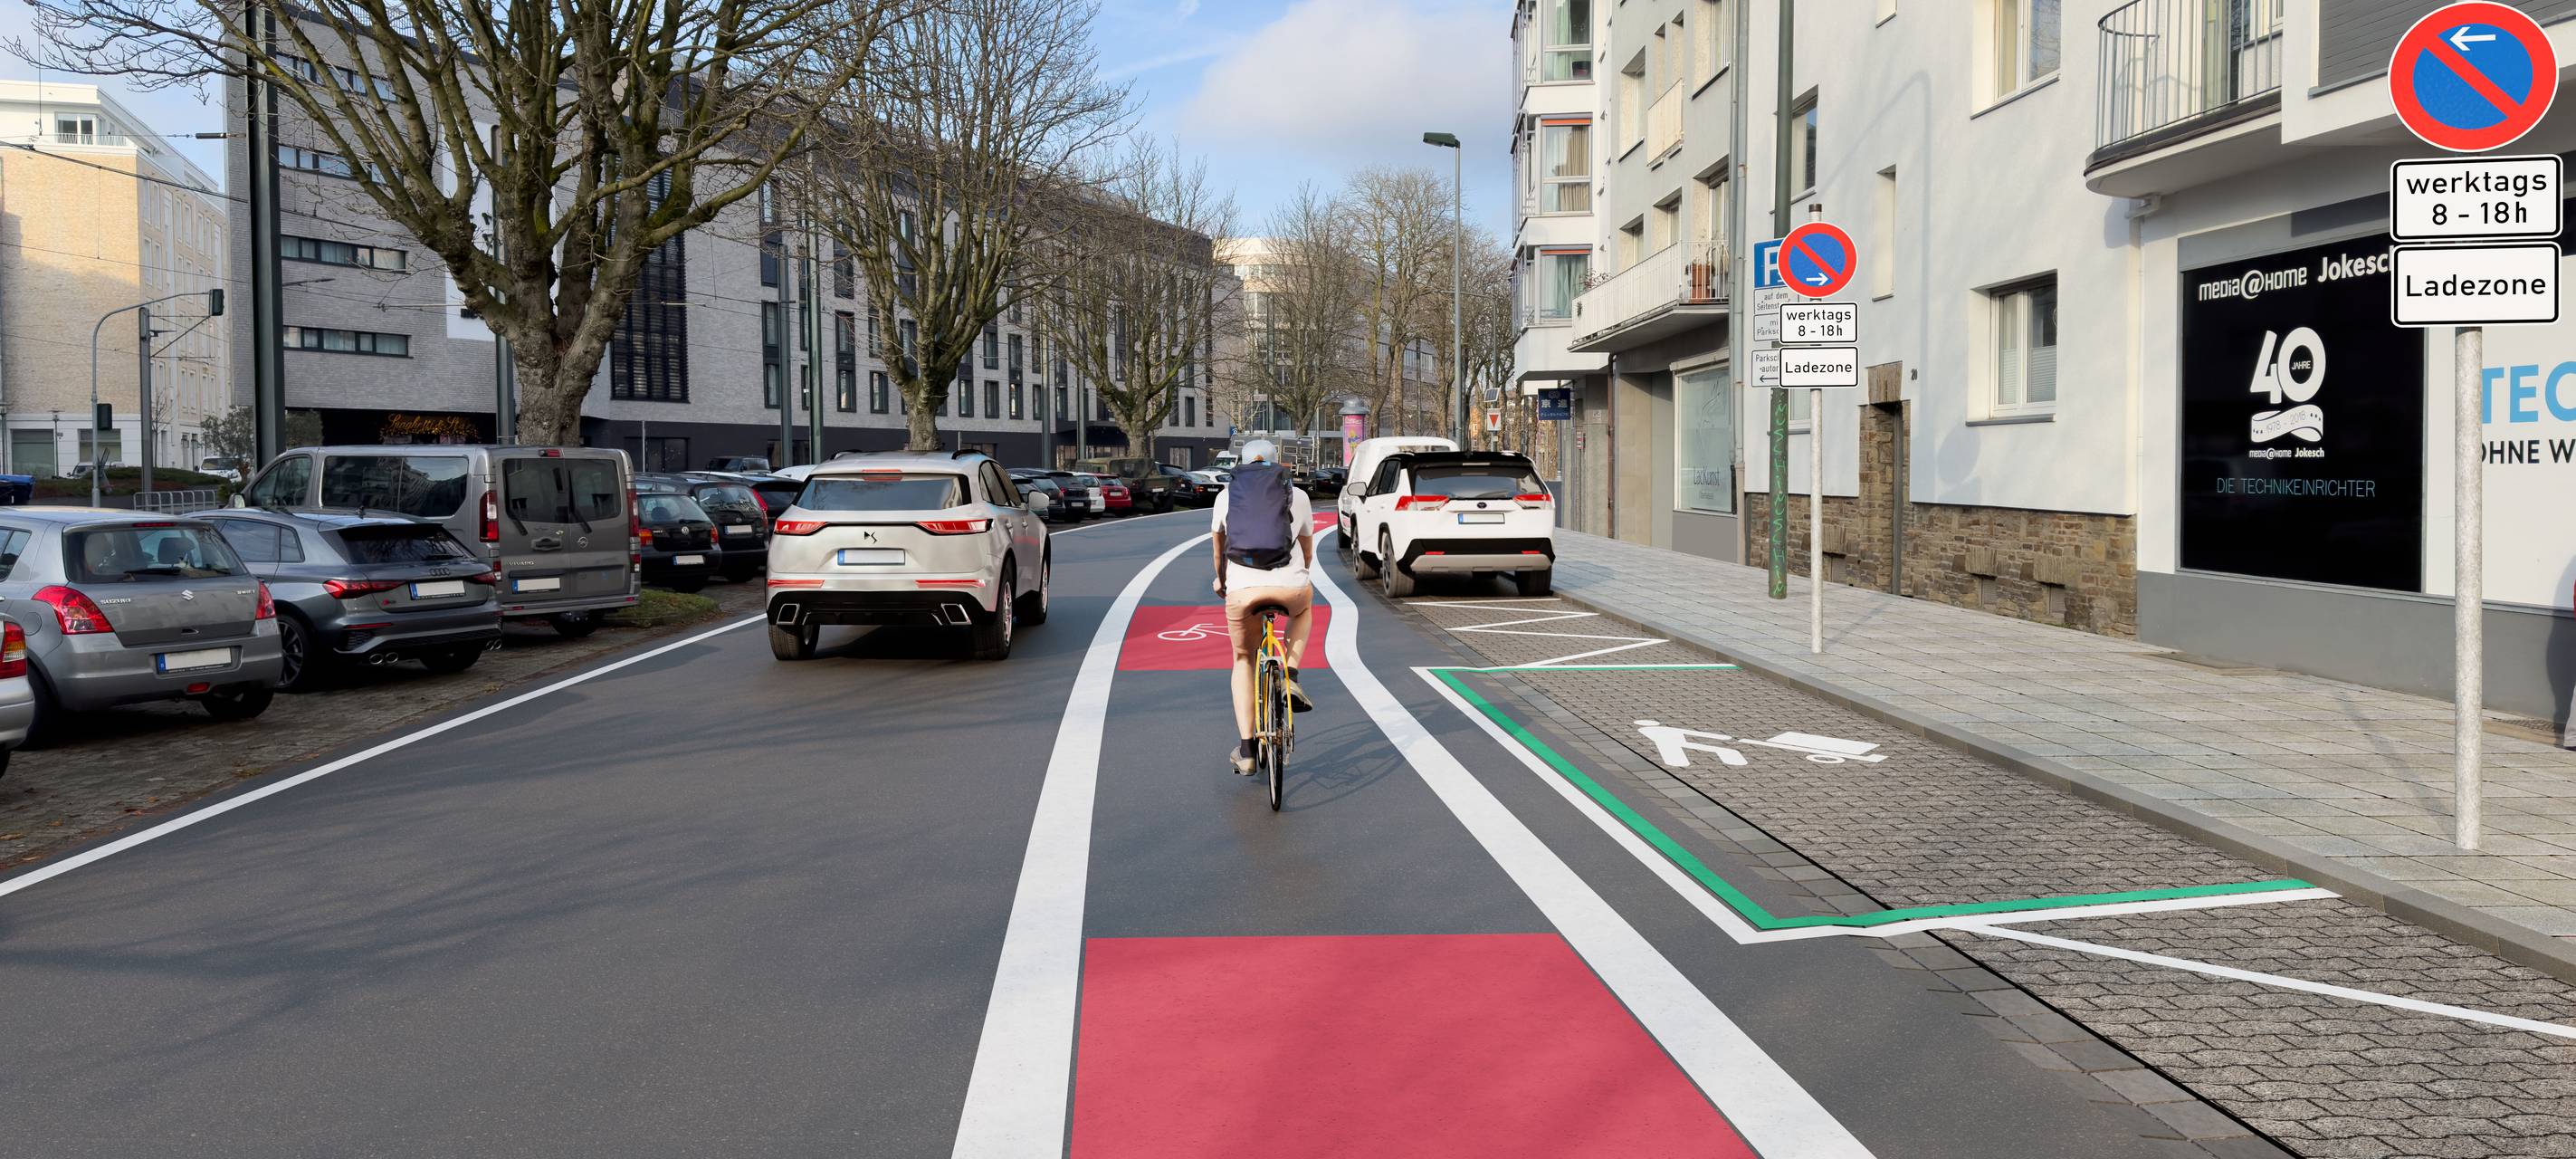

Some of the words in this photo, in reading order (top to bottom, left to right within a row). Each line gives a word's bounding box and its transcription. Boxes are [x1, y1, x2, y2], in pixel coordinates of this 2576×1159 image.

[2406, 171, 2547, 197] werktags
[2432, 203, 2447, 225] 8
[2406, 274, 2545, 297] Ladezone
[1776, 292, 1789, 300] dem
[1757, 302, 1779, 311] Seitenst
[1787, 309, 1852, 323] werktags
[1757, 328, 1779, 336] Parksc
[1798, 325, 1806, 336] 8
[1756, 354, 1779, 362] Parksc
[1785, 361, 1853, 373] Ladezone
[2250, 327, 2326, 404] 40
[2291, 360, 2312, 370] JAHRE
[2295, 446, 2325, 458] Jokesch
[2482, 440, 2540, 464] HNE
[2218, 478, 2236, 493] DIE
[2240, 478, 2376, 497] TECHNIKEINRICHTER
